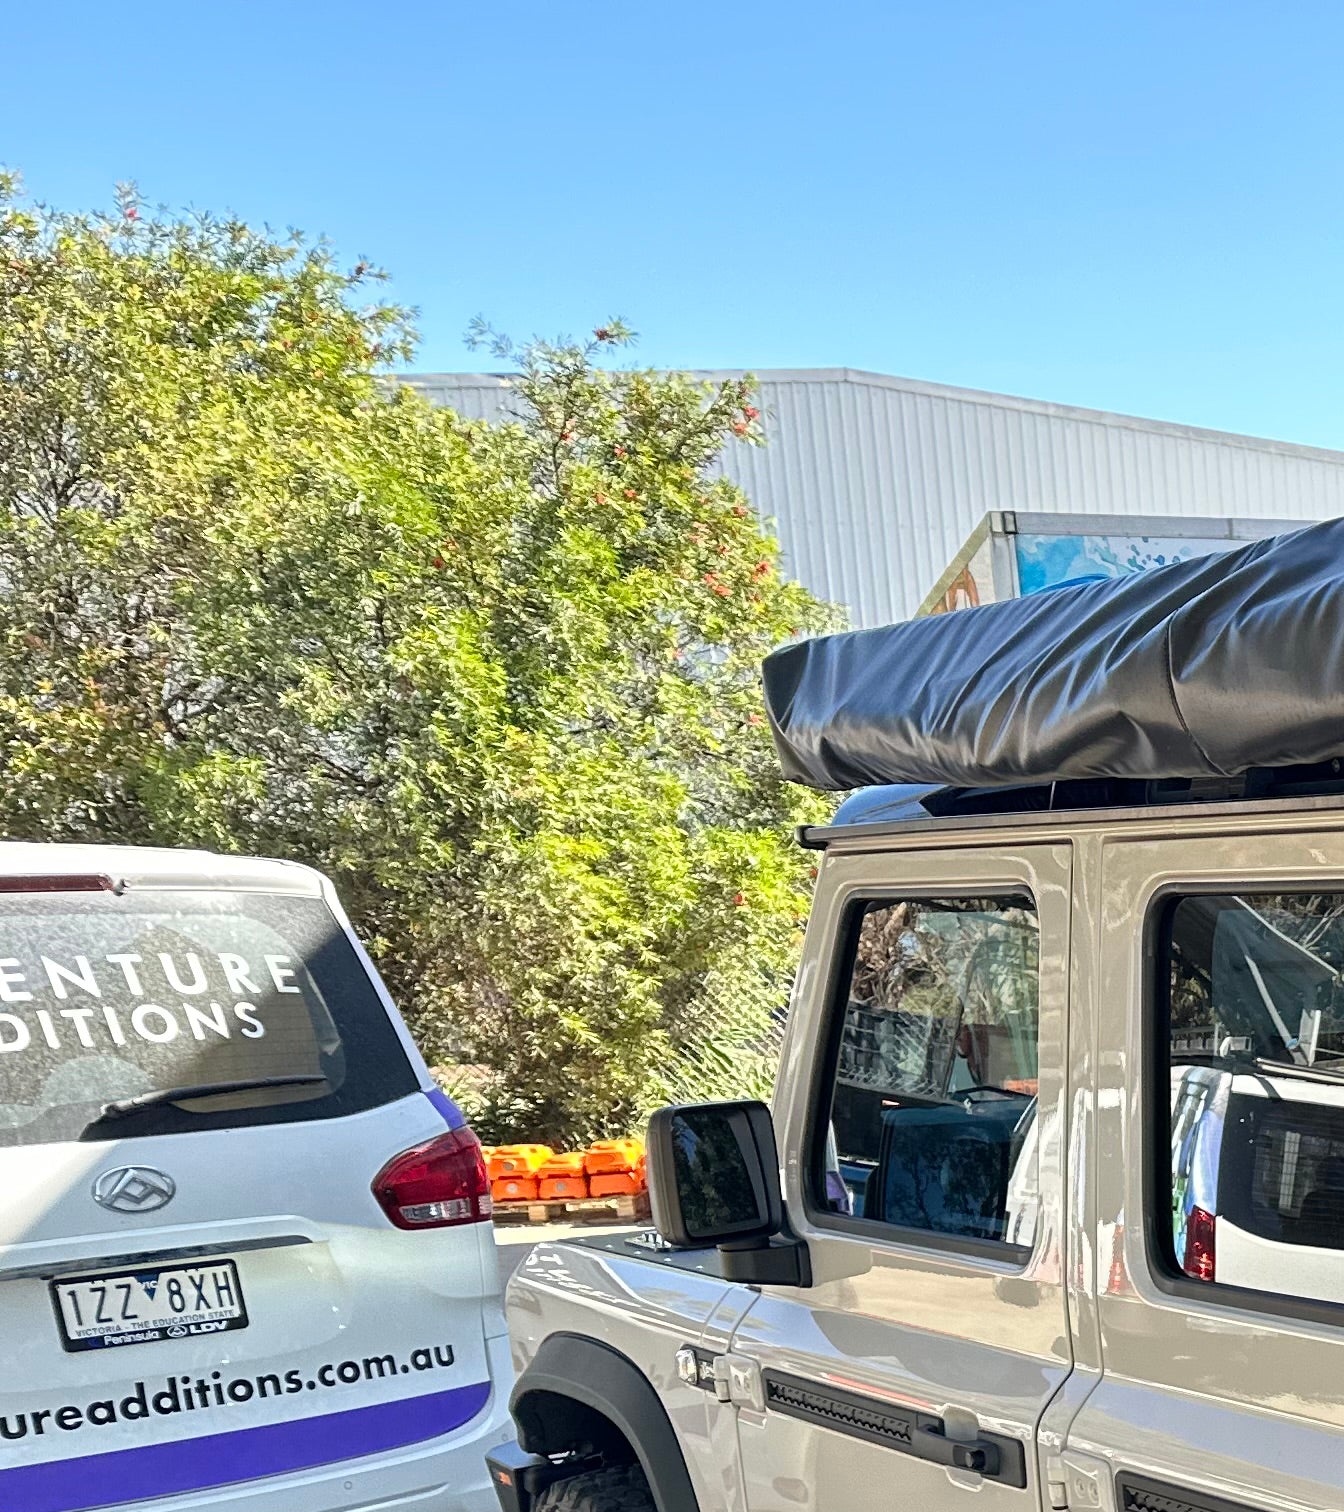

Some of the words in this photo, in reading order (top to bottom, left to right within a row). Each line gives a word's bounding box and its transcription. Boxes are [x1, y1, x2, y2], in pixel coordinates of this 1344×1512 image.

[67, 1283, 138, 1327] 1ZZ
[166, 1271, 235, 1313] 8XH
[75, 1325, 122, 1338] VICTORIA
[131, 1320, 150, 1330] THE
[153, 1313, 206, 1327] EDUCATION
[208, 1309, 235, 1320] STATE
[103, 1330, 160, 1346] Peninsula
[189, 1320, 228, 1334] LDV
[0, 1344, 456, 1440] ureadditions.com.au
